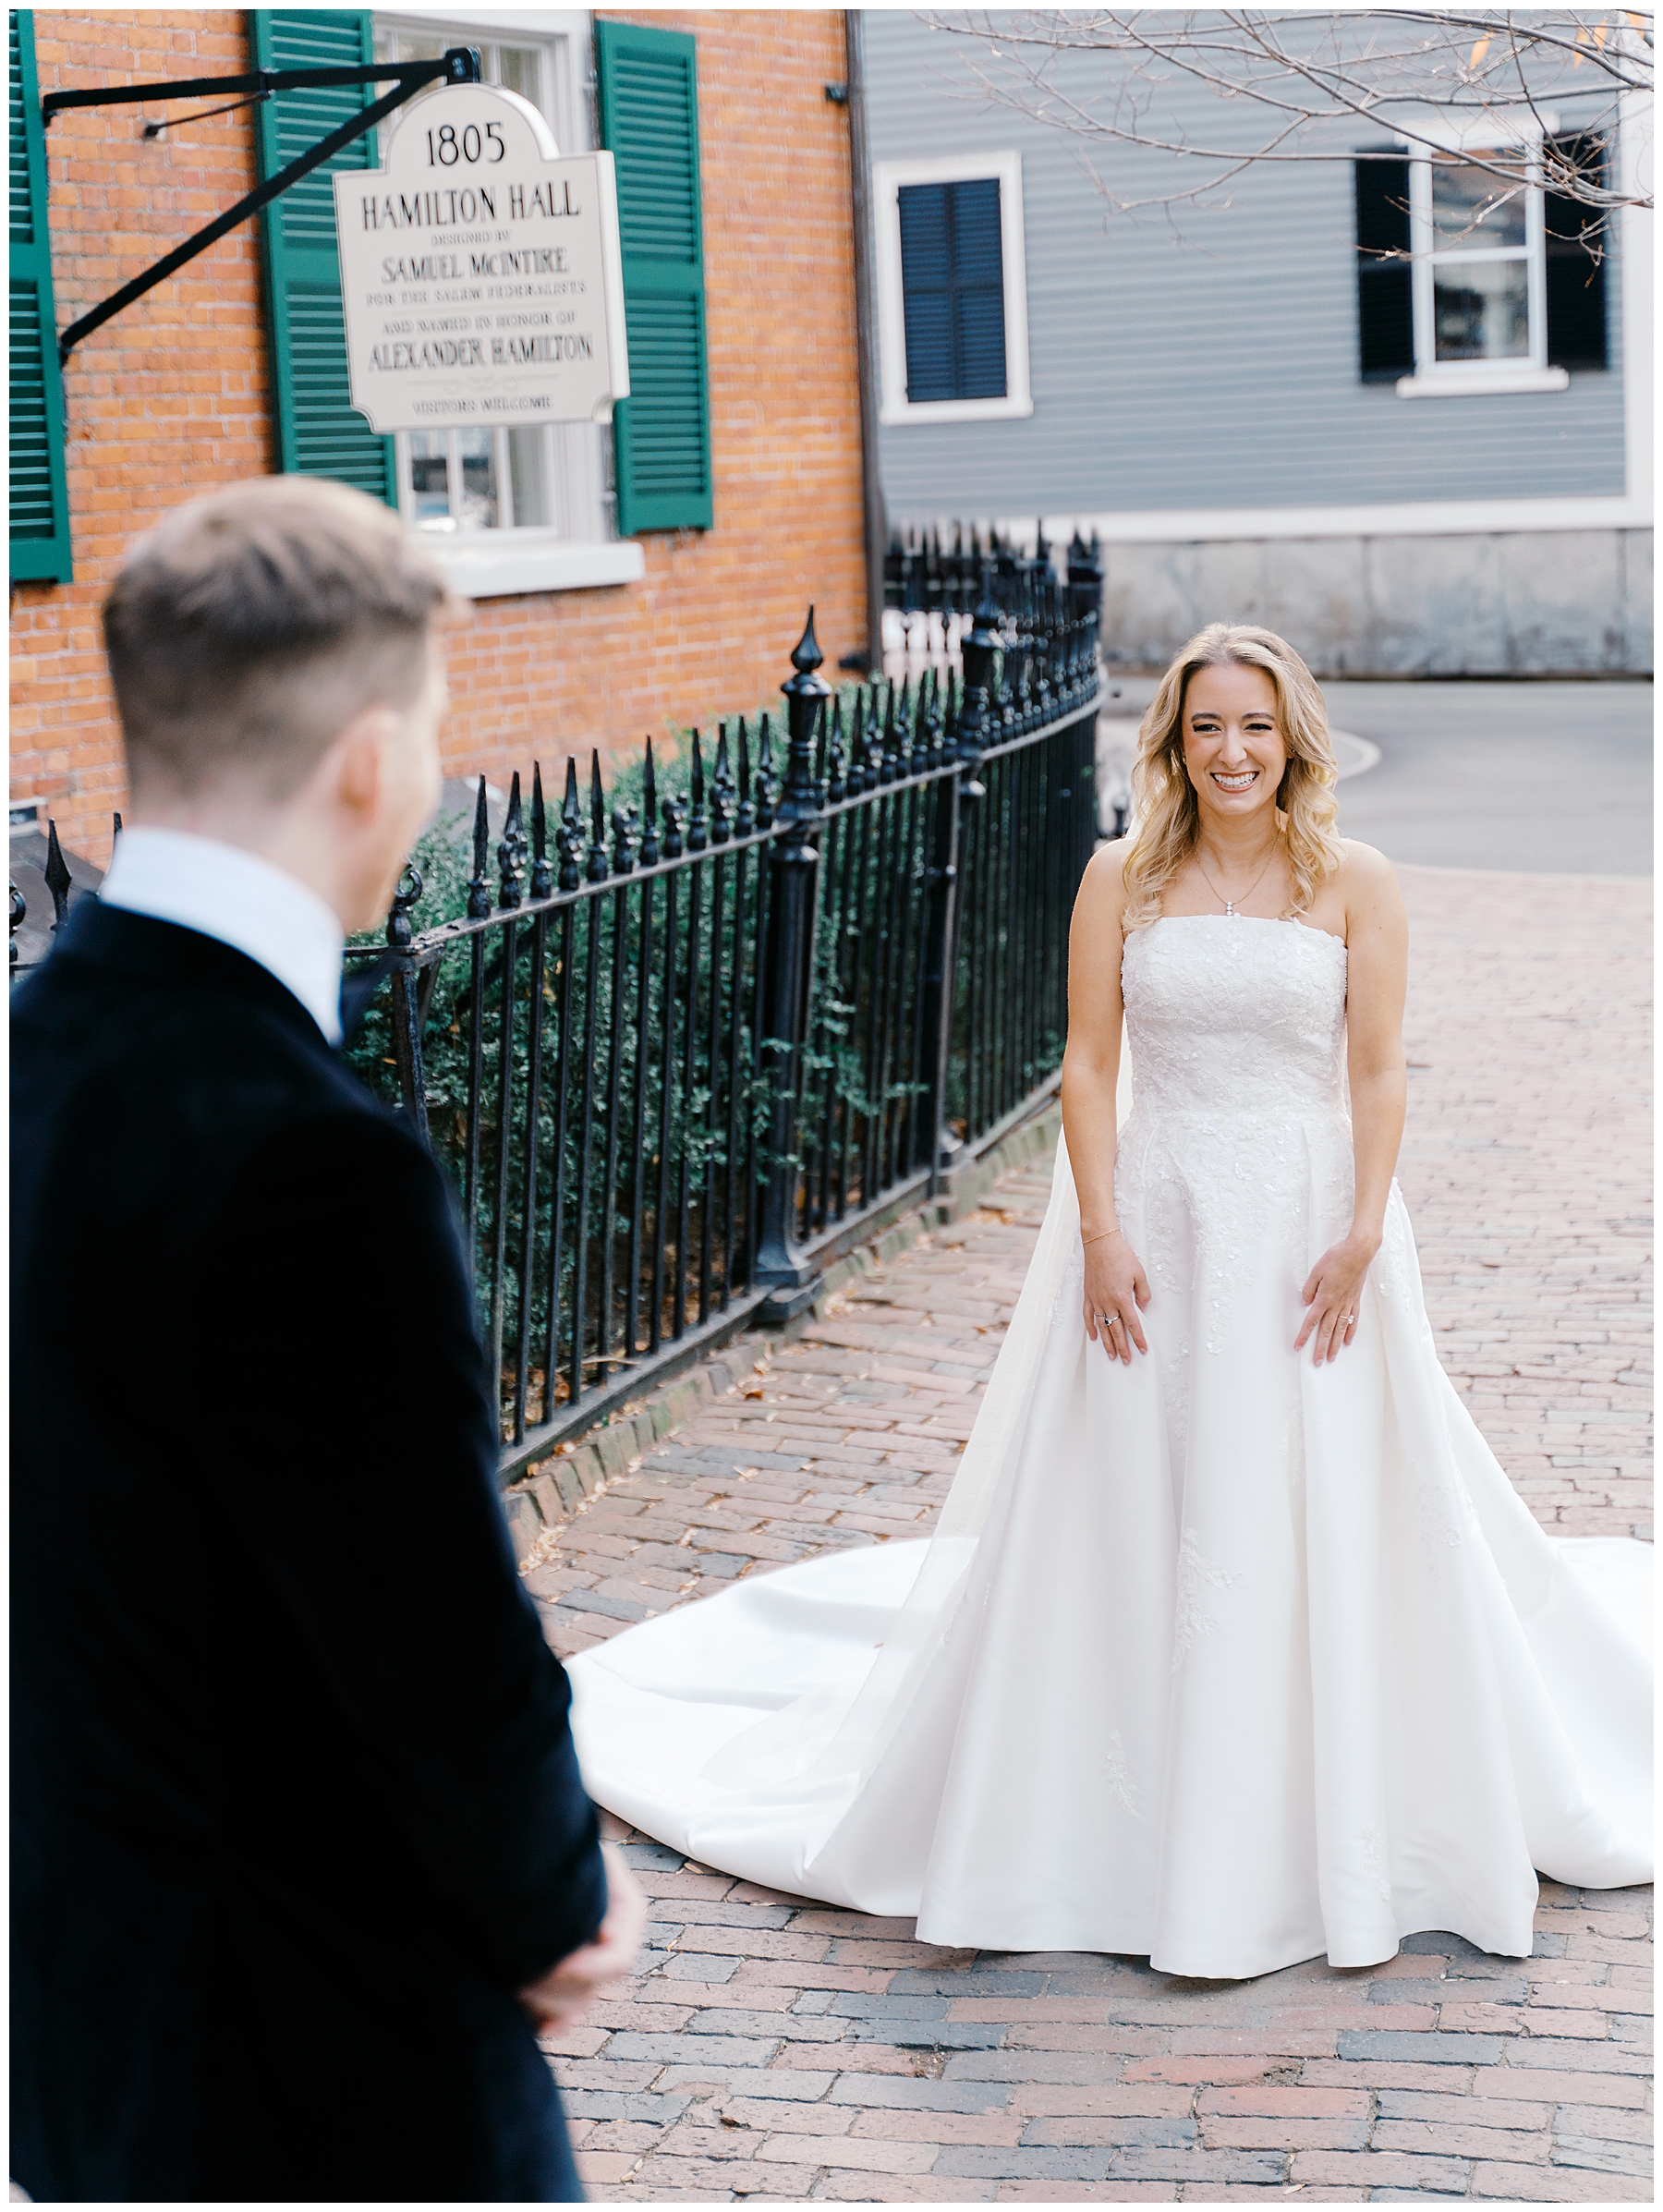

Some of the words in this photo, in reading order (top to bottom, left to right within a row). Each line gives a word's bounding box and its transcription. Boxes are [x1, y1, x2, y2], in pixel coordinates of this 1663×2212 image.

[426, 122, 505, 167] 1805
[361, 187, 498, 230] HAMILTON
[508, 181, 581, 220] HALL
[431, 232, 491, 246] DESIGNED
[494, 230, 511, 242] BY
[381, 251, 465, 284] SAMUEL
[366, 292, 395, 307] FOR
[401, 290, 428, 304] THE
[434, 287, 482, 302] SALEM
[487, 281, 588, 300] FEDERALISTS
[381, 321, 410, 335] AND
[417, 316, 471, 333] NAMED
[475, 315, 493, 330] IN
[496, 312, 552, 328] HONOR
[556, 310, 577, 323] OF
[370, 337, 486, 371] ALEXANDER
[490, 333, 594, 364] HAMILTON
[412, 399, 475, 414] VISITORS
[480, 395, 552, 411] WELCOME
